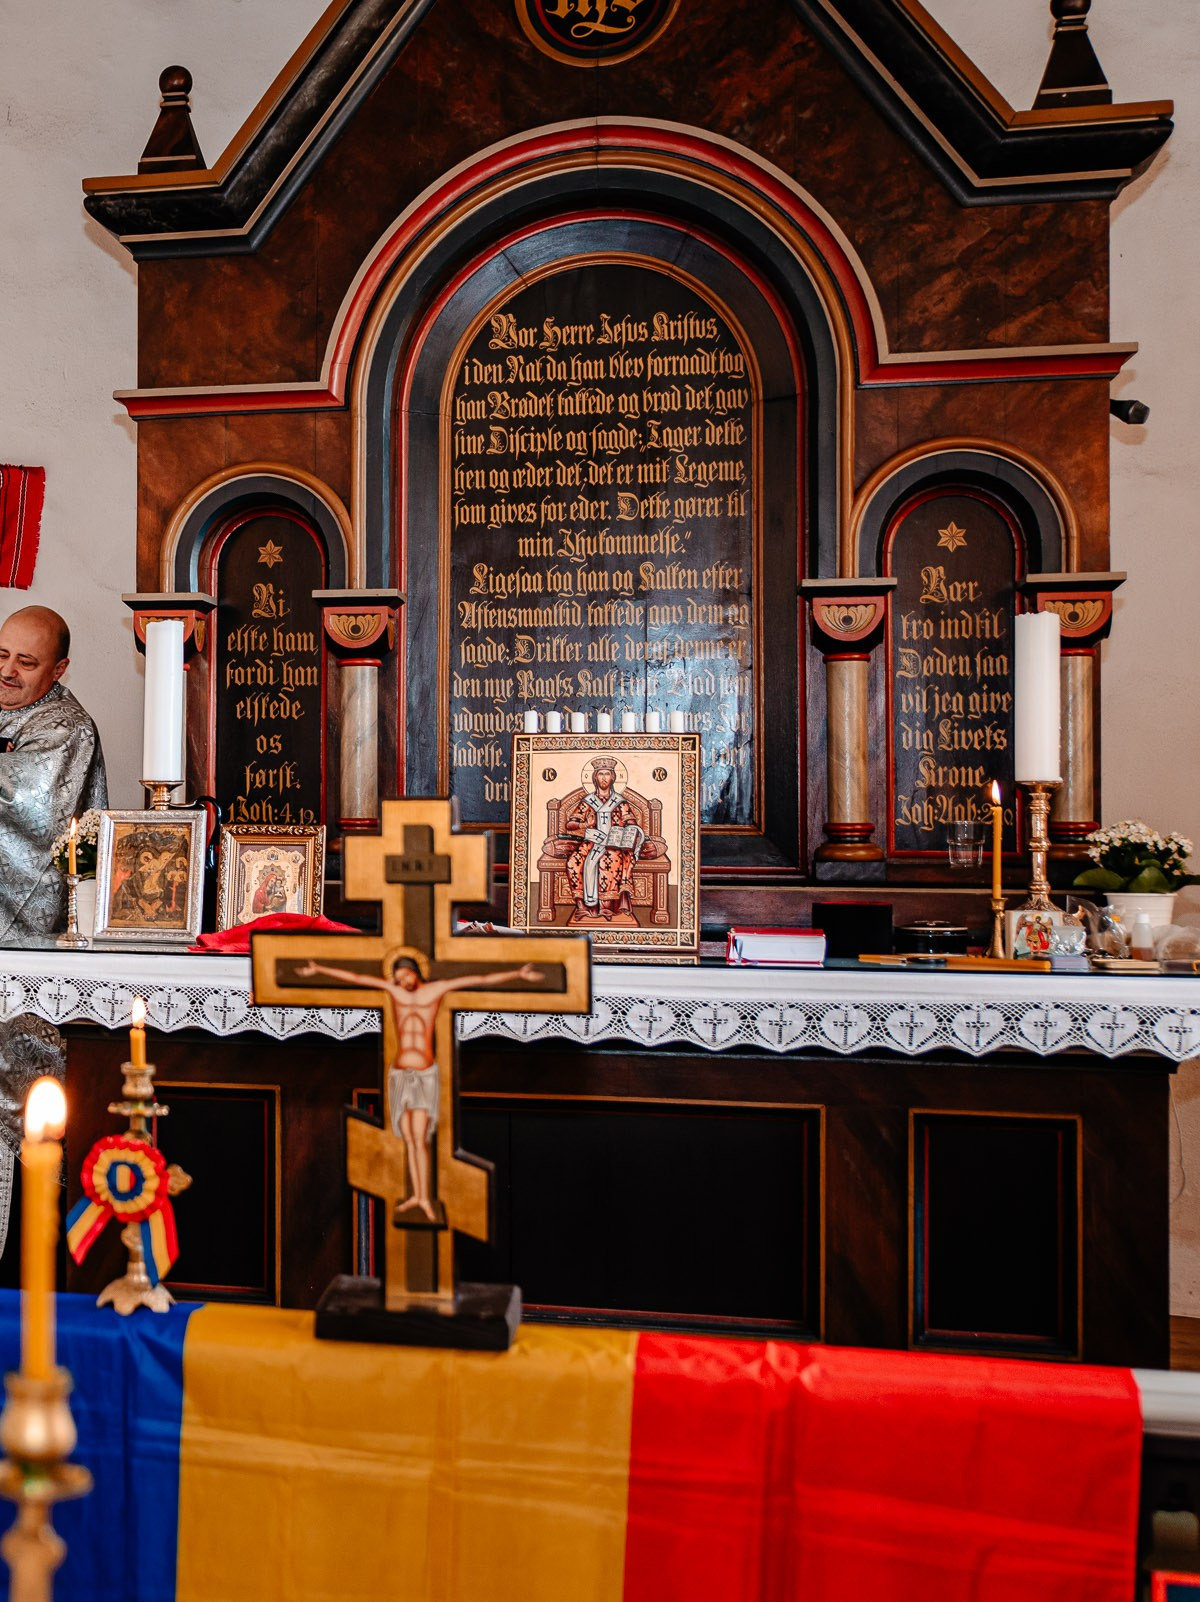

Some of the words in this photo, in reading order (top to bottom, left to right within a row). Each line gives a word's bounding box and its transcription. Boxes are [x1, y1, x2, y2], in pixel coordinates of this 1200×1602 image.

[539, 316, 595, 352] Herre
[473, 355, 505, 385] den
[546, 354, 568, 383] da
[567, 352, 607, 387] han
[609, 350, 644, 380] blev
[719, 347, 745, 379] tog
[453, 393, 487, 426] han
[557, 387, 615, 416] takkede
[618, 394, 641, 419] og
[643, 384, 682, 413] brød
[714, 388, 749, 416] gav
[565, 431, 588, 456] og
[704, 417, 748, 447] dette
[453, 462, 485, 495] hen
[489, 468, 511, 494] og
[587, 458, 617, 487] det
[616, 464, 634, 486] er
[637, 456, 671, 484] mit
[673, 454, 748, 488] Legeme,
[453, 497, 487, 530] som
[489, 498, 537, 529] gives
[540, 495, 568, 528] for
[568, 494, 612, 523] eder.
[616, 491, 672, 522] Dette
[725, 489, 749, 517] til
[517, 530, 555, 558] min
[546, 563, 573, 597] tog
[572, 564, 610, 598] han
[612, 569, 634, 596] og
[701, 560, 744, 592] efter
[648, 604, 683, 630] gav
[685, 597, 724, 625] dem
[727, 603, 749, 630] og
[900, 610, 934, 641] tro
[939, 607, 1006, 640] indtil
[227, 622, 269, 657] elske
[271, 622, 318, 657] ham,
[586, 632, 621, 662] alle
[728, 640, 749, 660] er
[226, 658, 280, 690] fordi
[281, 657, 318, 692] han
[453, 671, 483, 698] den
[482, 677, 514, 703] nye
[236, 691, 305, 727] elskede
[901, 684, 931, 714] vil
[931, 684, 965, 720] jeg
[967, 683, 1013, 720] give
[256, 734, 283, 755] os
[901, 721, 934, 755] dig
